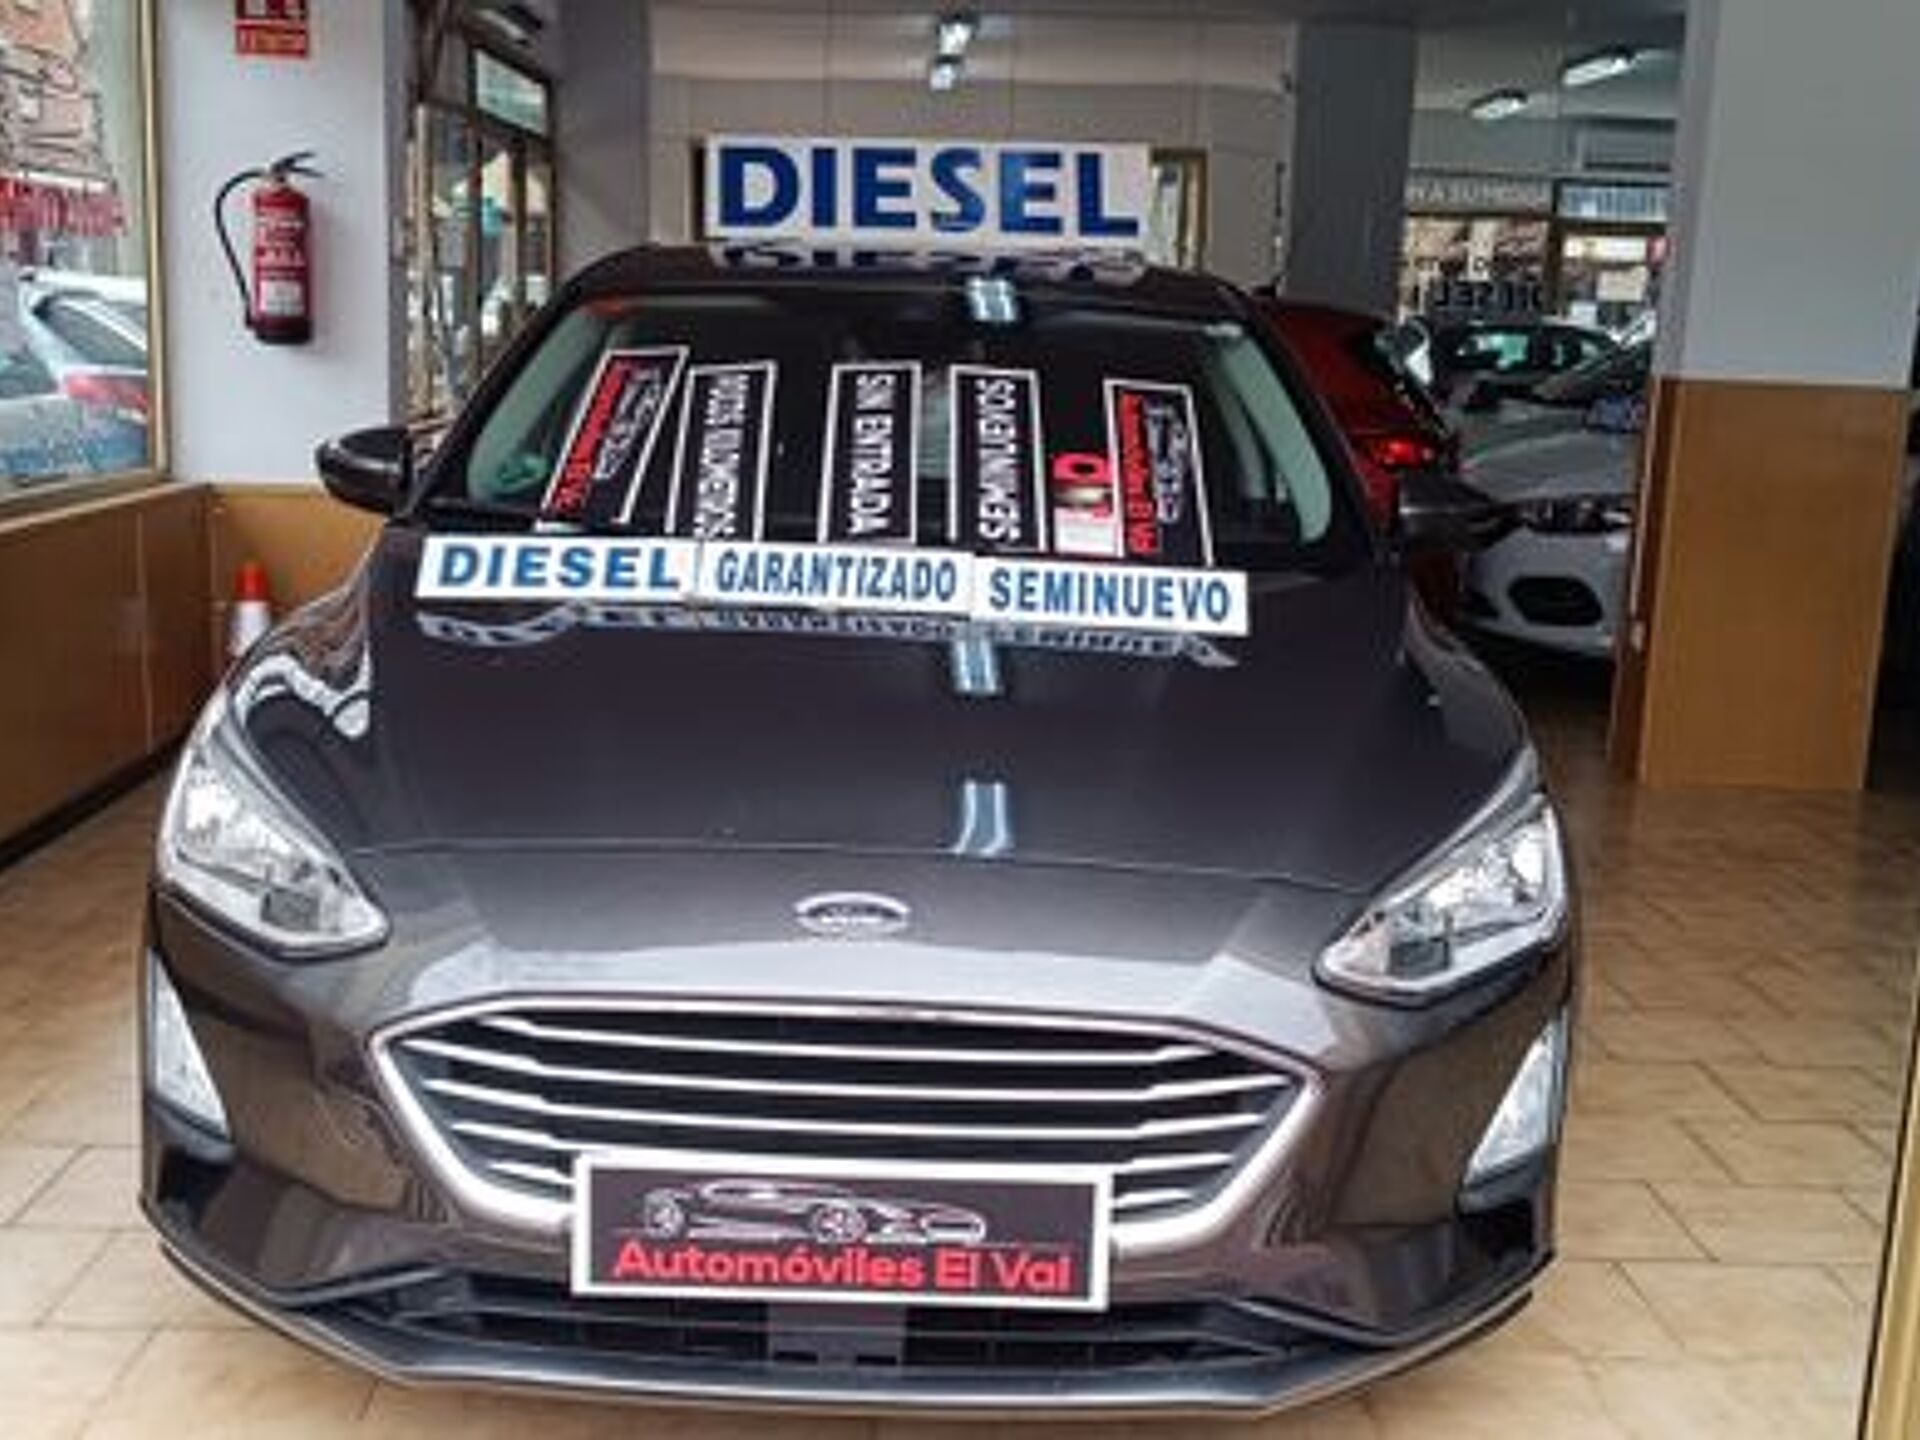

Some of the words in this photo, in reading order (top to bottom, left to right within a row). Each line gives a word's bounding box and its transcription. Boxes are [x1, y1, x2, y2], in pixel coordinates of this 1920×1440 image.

[719, 147, 1139, 237] DIESEL
[856, 374, 896, 411] SIN
[847, 415, 893, 535] ENTRADA
[975, 379, 1020, 541] SEMINUEVOS
[438, 545, 680, 588] DIESEL
[716, 552, 957, 601] GARANTIZADO
[989, 568, 1230, 622] SEMINUEVO
[613, 1241, 924, 1287] Automóviles
[935, 1250, 979, 1289] El
[993, 1252, 1070, 1291] Val
